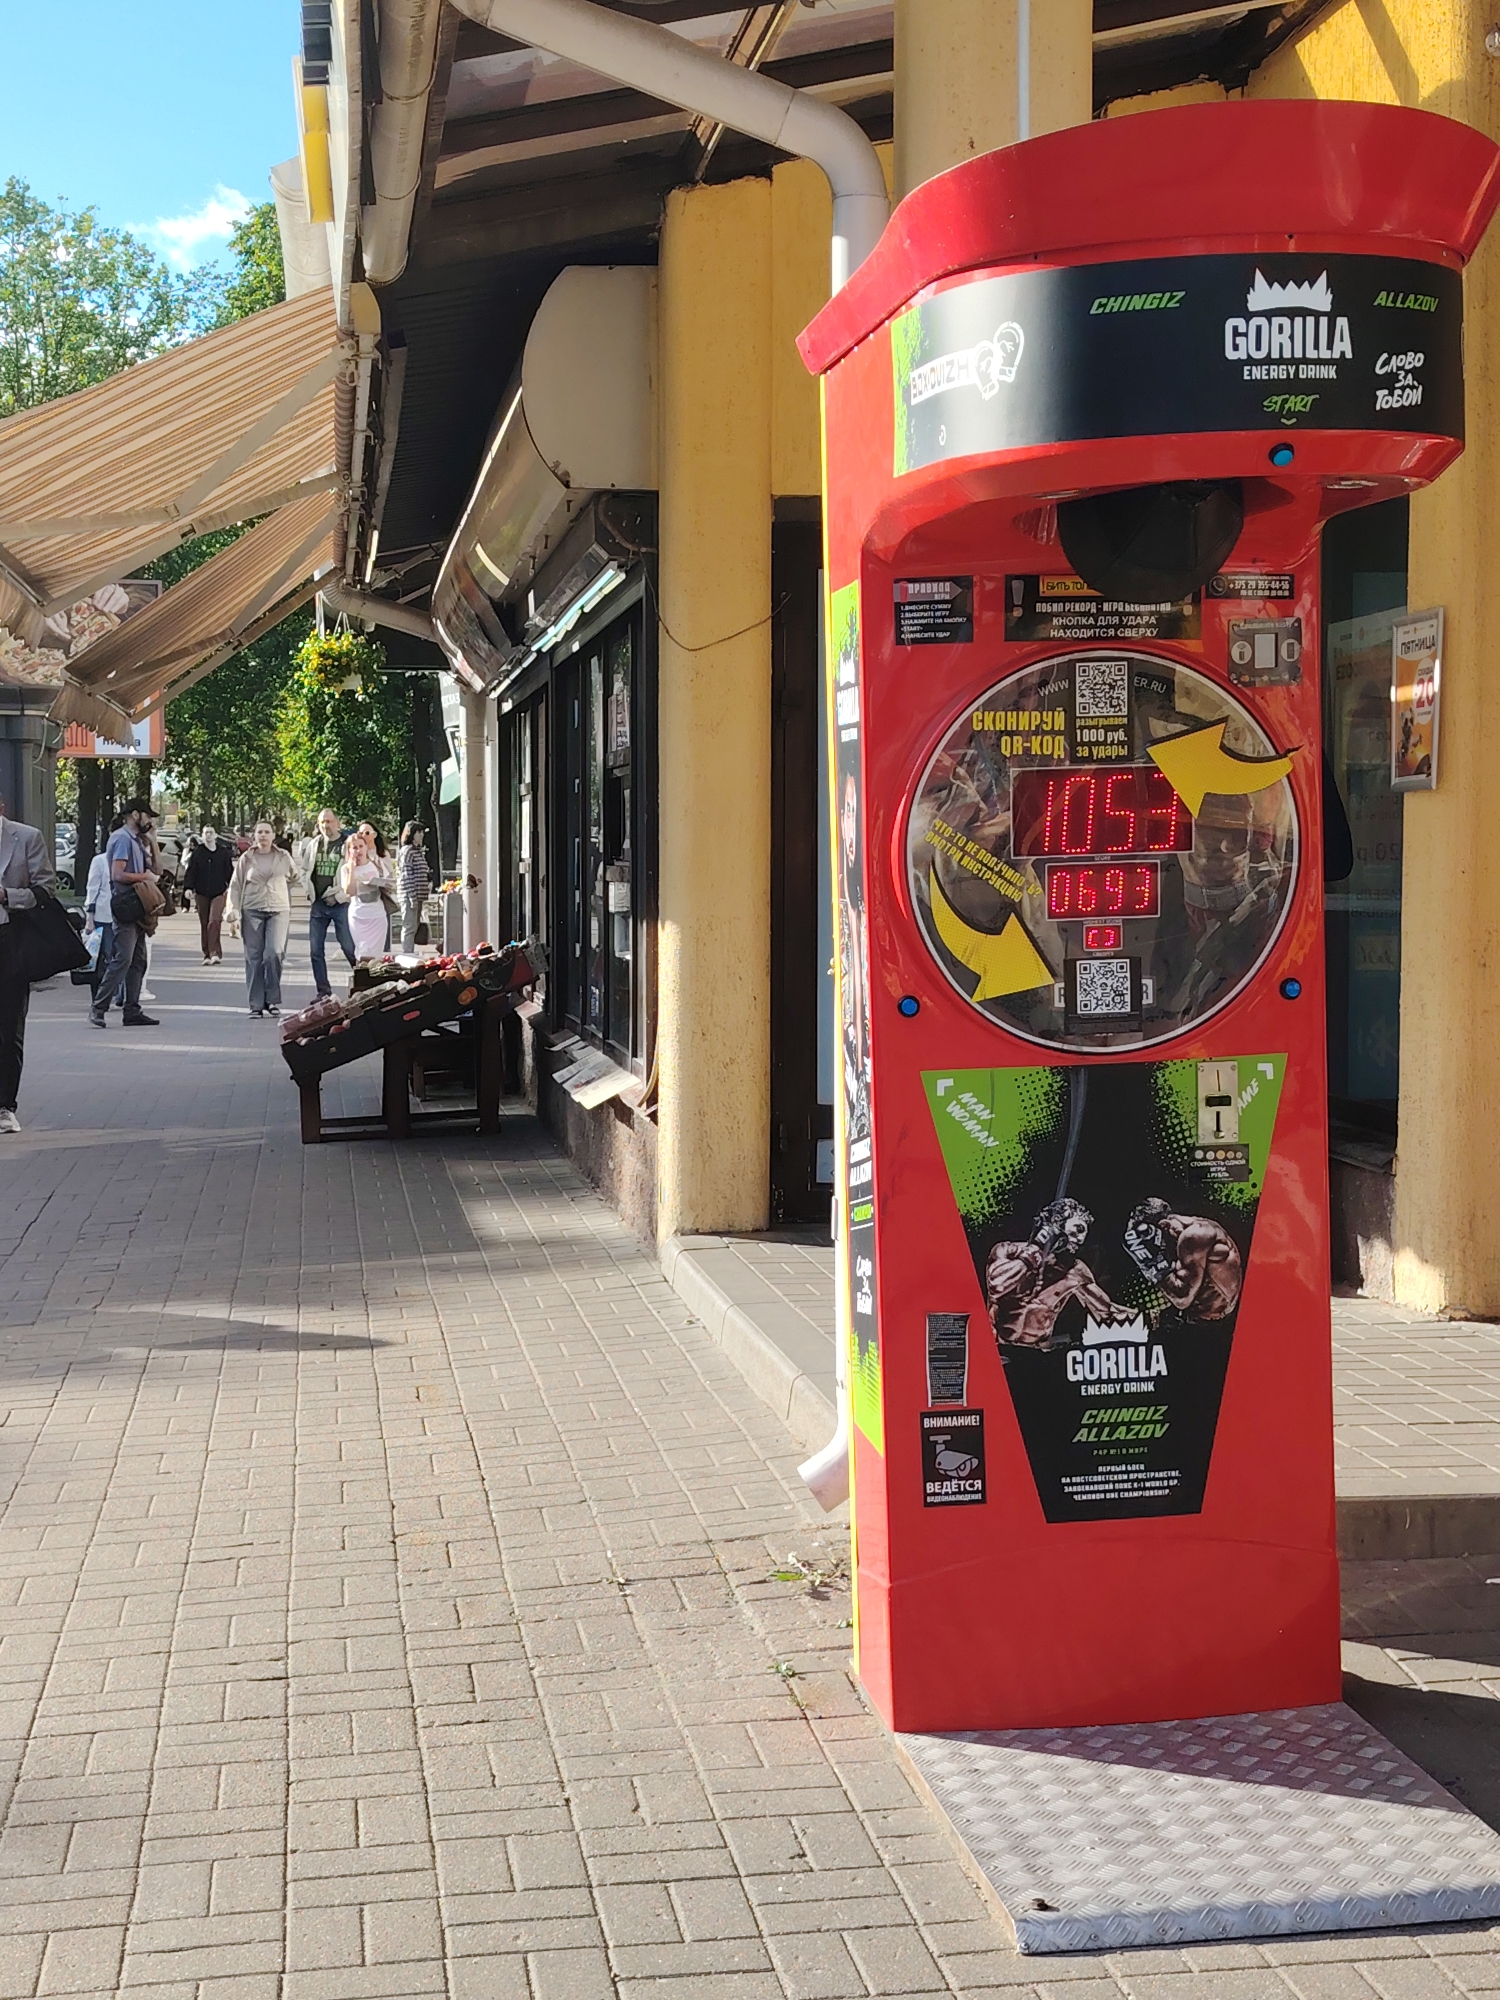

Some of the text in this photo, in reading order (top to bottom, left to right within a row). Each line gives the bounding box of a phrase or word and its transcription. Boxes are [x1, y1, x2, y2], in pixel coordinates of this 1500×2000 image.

[1089, 291, 1439, 314] CHINGIZ ALLAZOV
[1224, 316, 1353, 360] GORILLA
[1243, 364, 1337, 380] ENERGY DRINK
[1263, 394, 1319, 414] START
[908, 582, 951, 594] ПРАВИЛА
[1071, 581, 1089, 591] ТОЛ
[1036, 602, 1064, 613] ПОБИЛ
[1065, 602, 1097, 614] РЕКОРД
[1103, 602, 1124, 612] ИГРА
[1052, 616, 1156, 627] КНОПКА ДЛЯ УДАРА
[1050, 627, 1159, 639] НАХОДИТСЯ СВЕРХУ
[1401, 635, 1436, 655] ПЯТНИЦА
[1037, 675, 1167, 697] WWW ER.RU
[972, 707, 1065, 731] СКАНИРУЙ
[1075, 717, 1128, 727] разыгрываем
[1076, 729, 1128, 745] 1000 руб.
[1000, 735, 1065, 759] QR-КОД
[1075, 745, 1128, 759] за удары
[1043, 773, 1179, 853] 1053
[934, 818, 967, 847] ЧТО-ТО
[964, 840, 980, 856] НЕ
[924, 831, 1024, 903] СМОТРИ ИНСТРУКЦИЮ
[1051, 867, 1151, 913] 0693
[958, 1092, 995, 1120] MAN
[1237, 1078, 1259, 1116] AME
[946, 1100, 999, 1147] WOMAN
[1124, 1230, 1153, 1261] ONE
[1066, 1345, 1168, 1382] GORILLA
[1081, 1381, 1155, 1396] ENERGY DRINK
[923, 1415, 980, 1428] ВНИМАНИЕ!
[1081, 1405, 1169, 1424] CHINGIZ
[1071, 1423, 1170, 1443] ALLAZOV
[1098, 1464, 1126, 1473] ПЕРВЫЙ
[925, 1479, 982, 1494] ВЕДЁТСЯ
[1061, 1476, 1071, 1484] НА
[1071, 1473, 1128, 1483] ПОСТСОВЕТСКОМ
[1063, 1482, 1114, 1493] ЗАВОЕВАВШИЙ
[1144, 1480, 1168, 1488] WORLD
[926, 1493, 982, 1503] ВИДЕОНАБЛЮДЕНИЕ
[1073, 1493, 1105, 1501] ЧЕМПИОН
